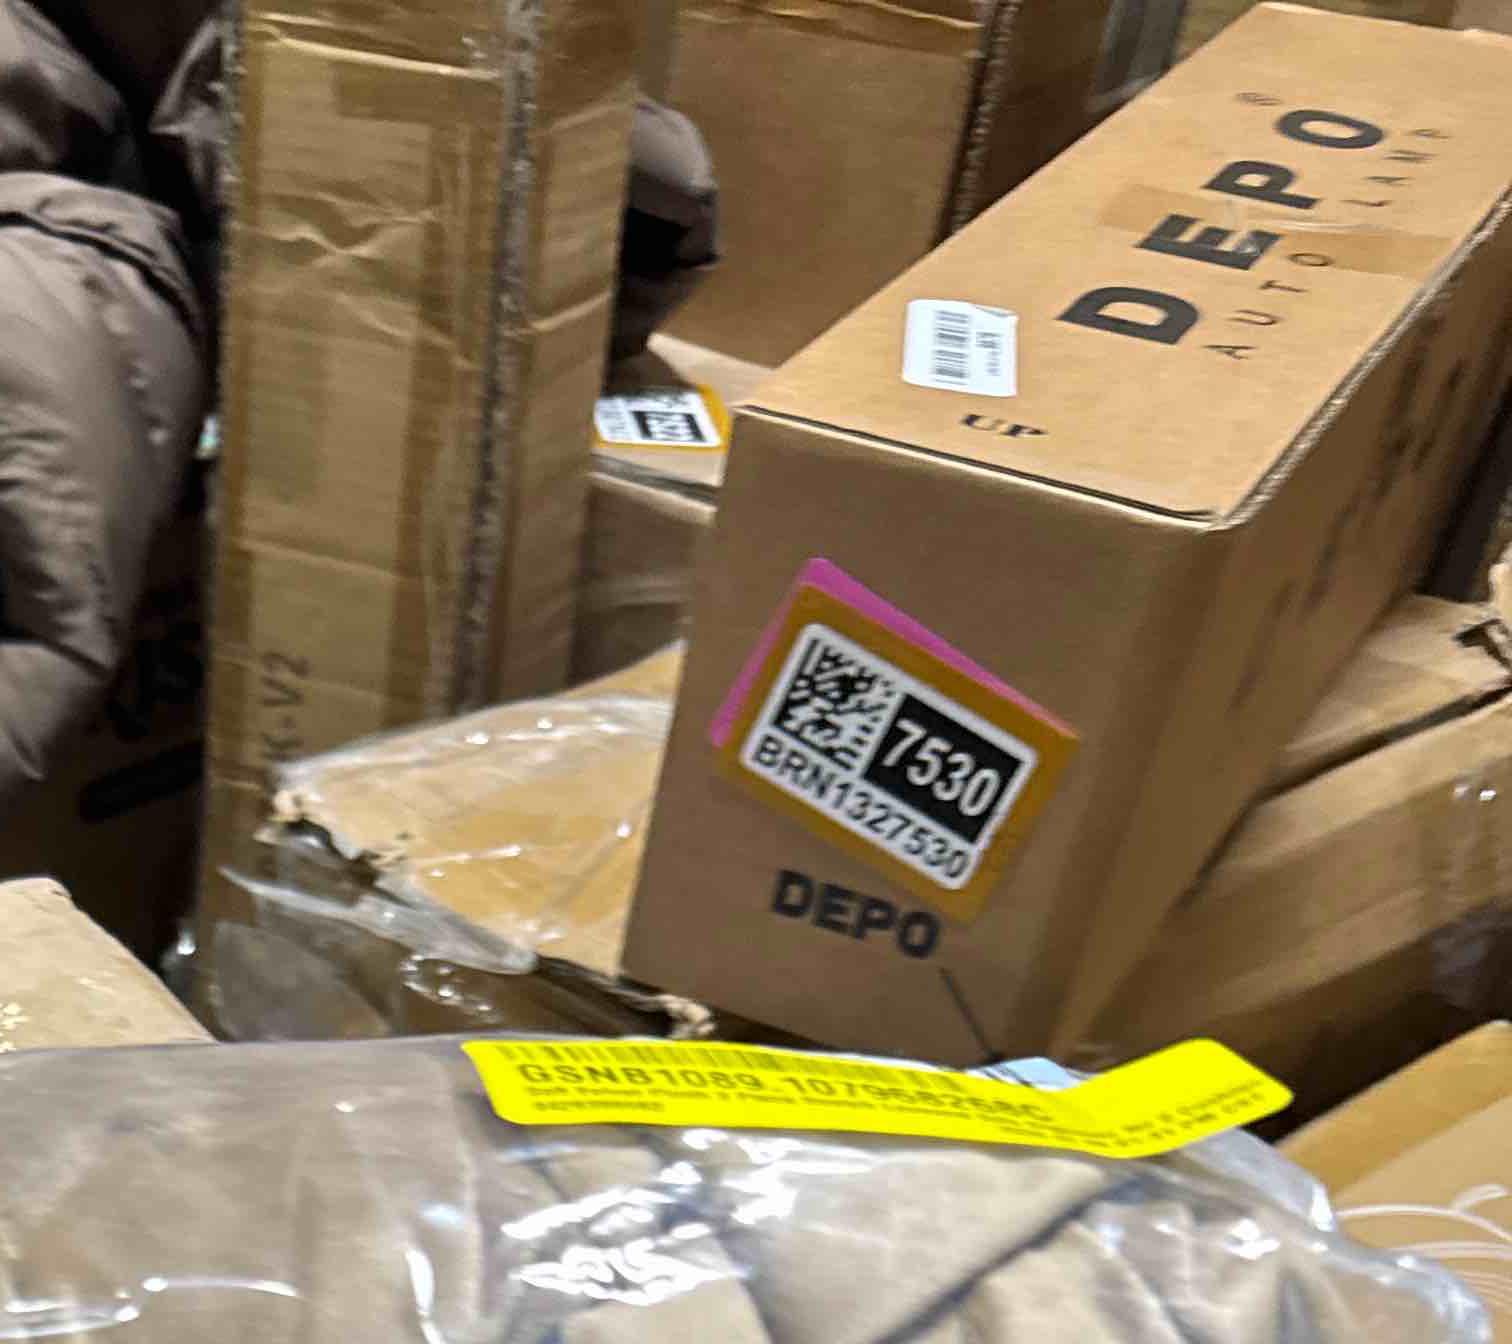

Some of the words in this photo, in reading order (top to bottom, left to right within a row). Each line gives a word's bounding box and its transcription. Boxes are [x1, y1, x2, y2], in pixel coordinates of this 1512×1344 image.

[1055, 109, 1385, 346] DEPO
[1201, 252, 1335, 361] AUTO
[960, 414, 1050, 438] UP
[752, 735, 969, 879] BRN1327530
[881, 719, 1001, 817] 7530
[769, 868, 941, 960] DEPO
